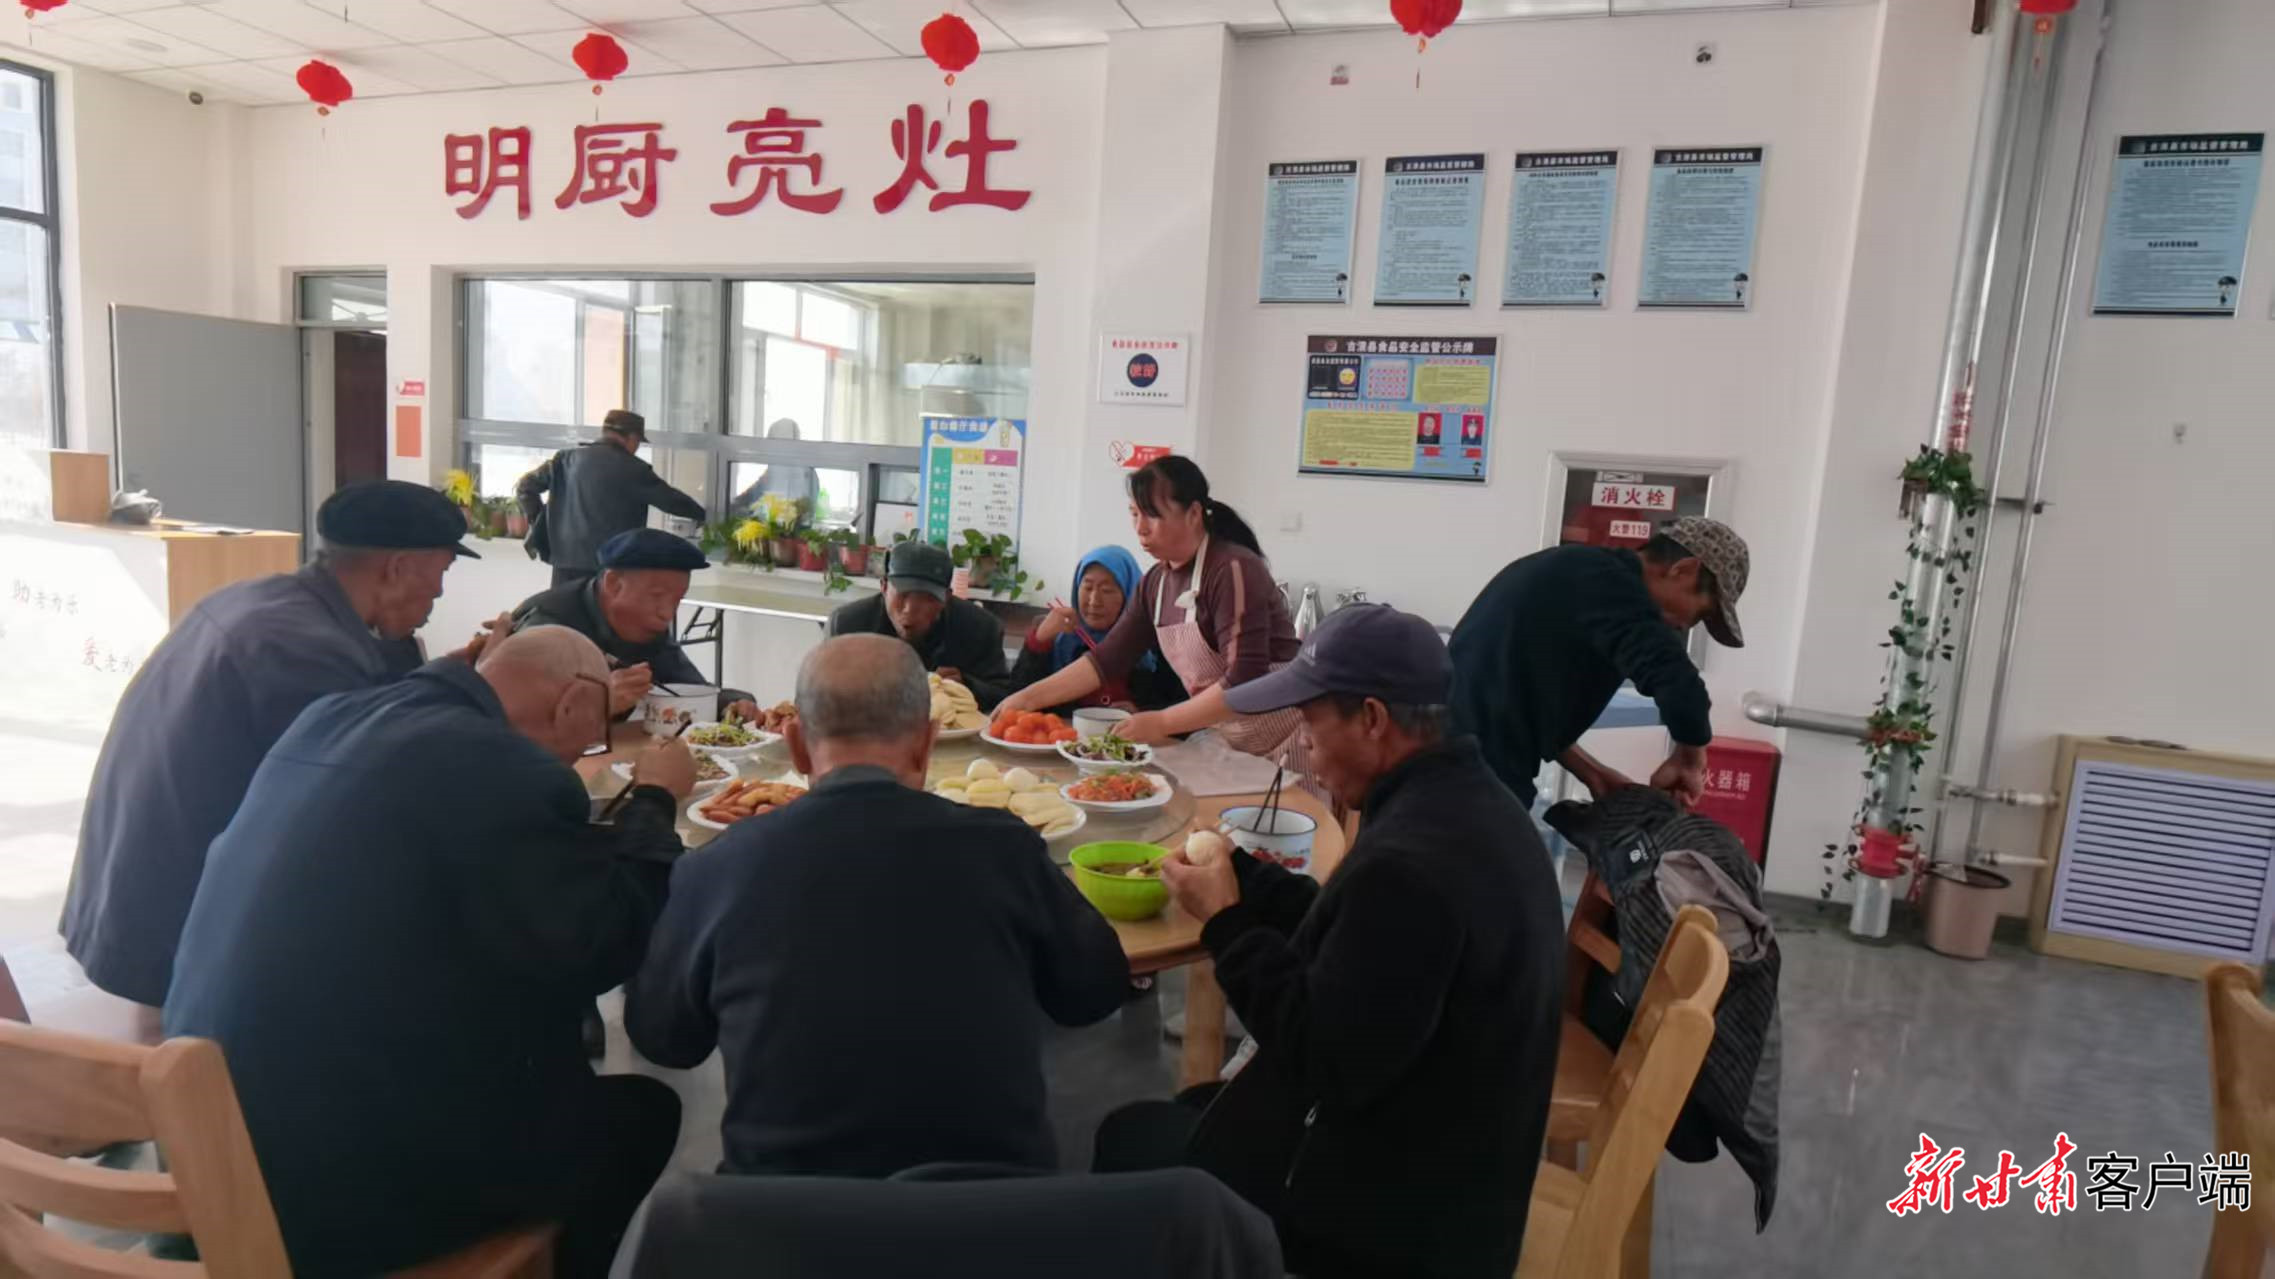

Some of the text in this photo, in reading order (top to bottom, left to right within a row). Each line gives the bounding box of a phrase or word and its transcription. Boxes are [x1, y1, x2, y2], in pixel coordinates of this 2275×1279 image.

[444, 98, 1031, 220] 明厨亮灶
[1601, 486, 1665, 507] 消火栓
[1611, 522, 1648, 537] 火警119
[1701, 767, 1752, 792] 火器箱
